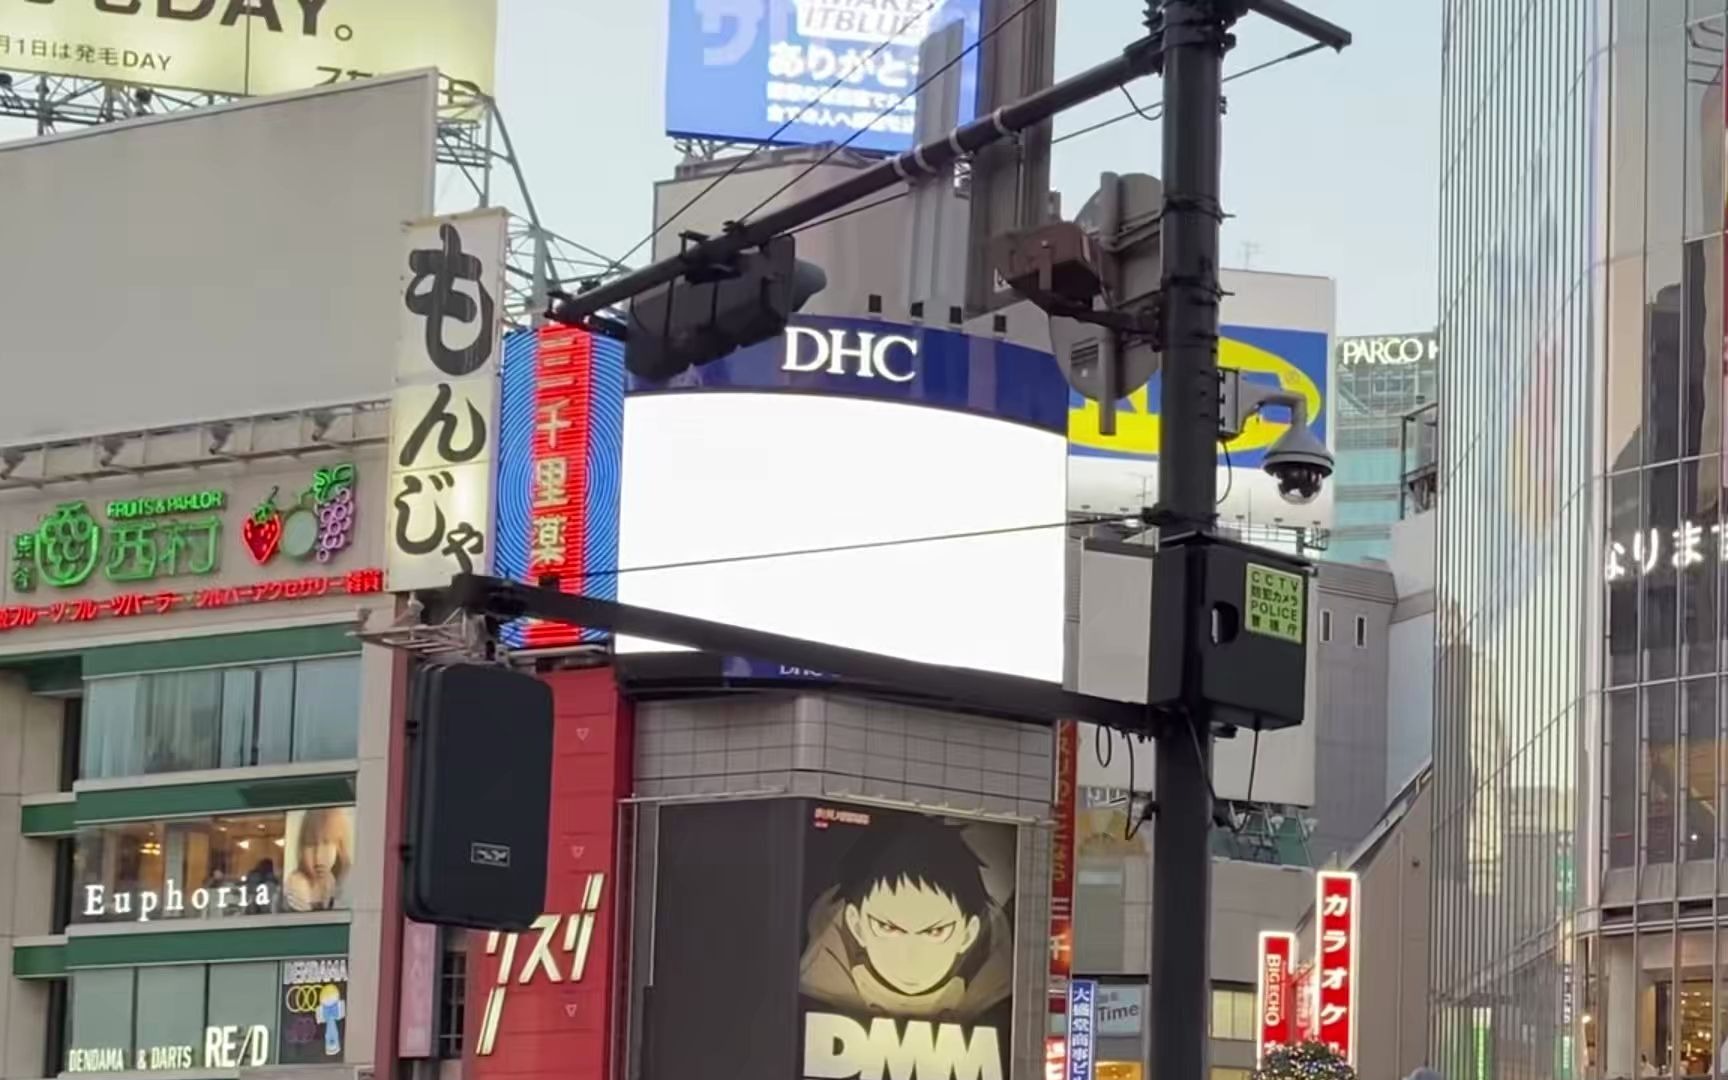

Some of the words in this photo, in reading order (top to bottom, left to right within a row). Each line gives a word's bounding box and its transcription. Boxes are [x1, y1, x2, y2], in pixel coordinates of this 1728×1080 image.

[768, 41, 919, 86] ありがと
[782, 326, 918, 382] DHC
[1343, 337, 1423, 365] PARCO
[394, 223, 496, 576] もんじゃ
[1251, 571, 1298, 593] CCTV
[1251, 599, 1298, 622] POLICE
[84, 876, 271, 922] Euphoria
[1322, 893, 1349, 1026] カラオケ
[1097, 1006, 1139, 1023] Time
[151, 1046, 192, 1069] DARTS
[205, 1025, 269, 1068] RE/D
